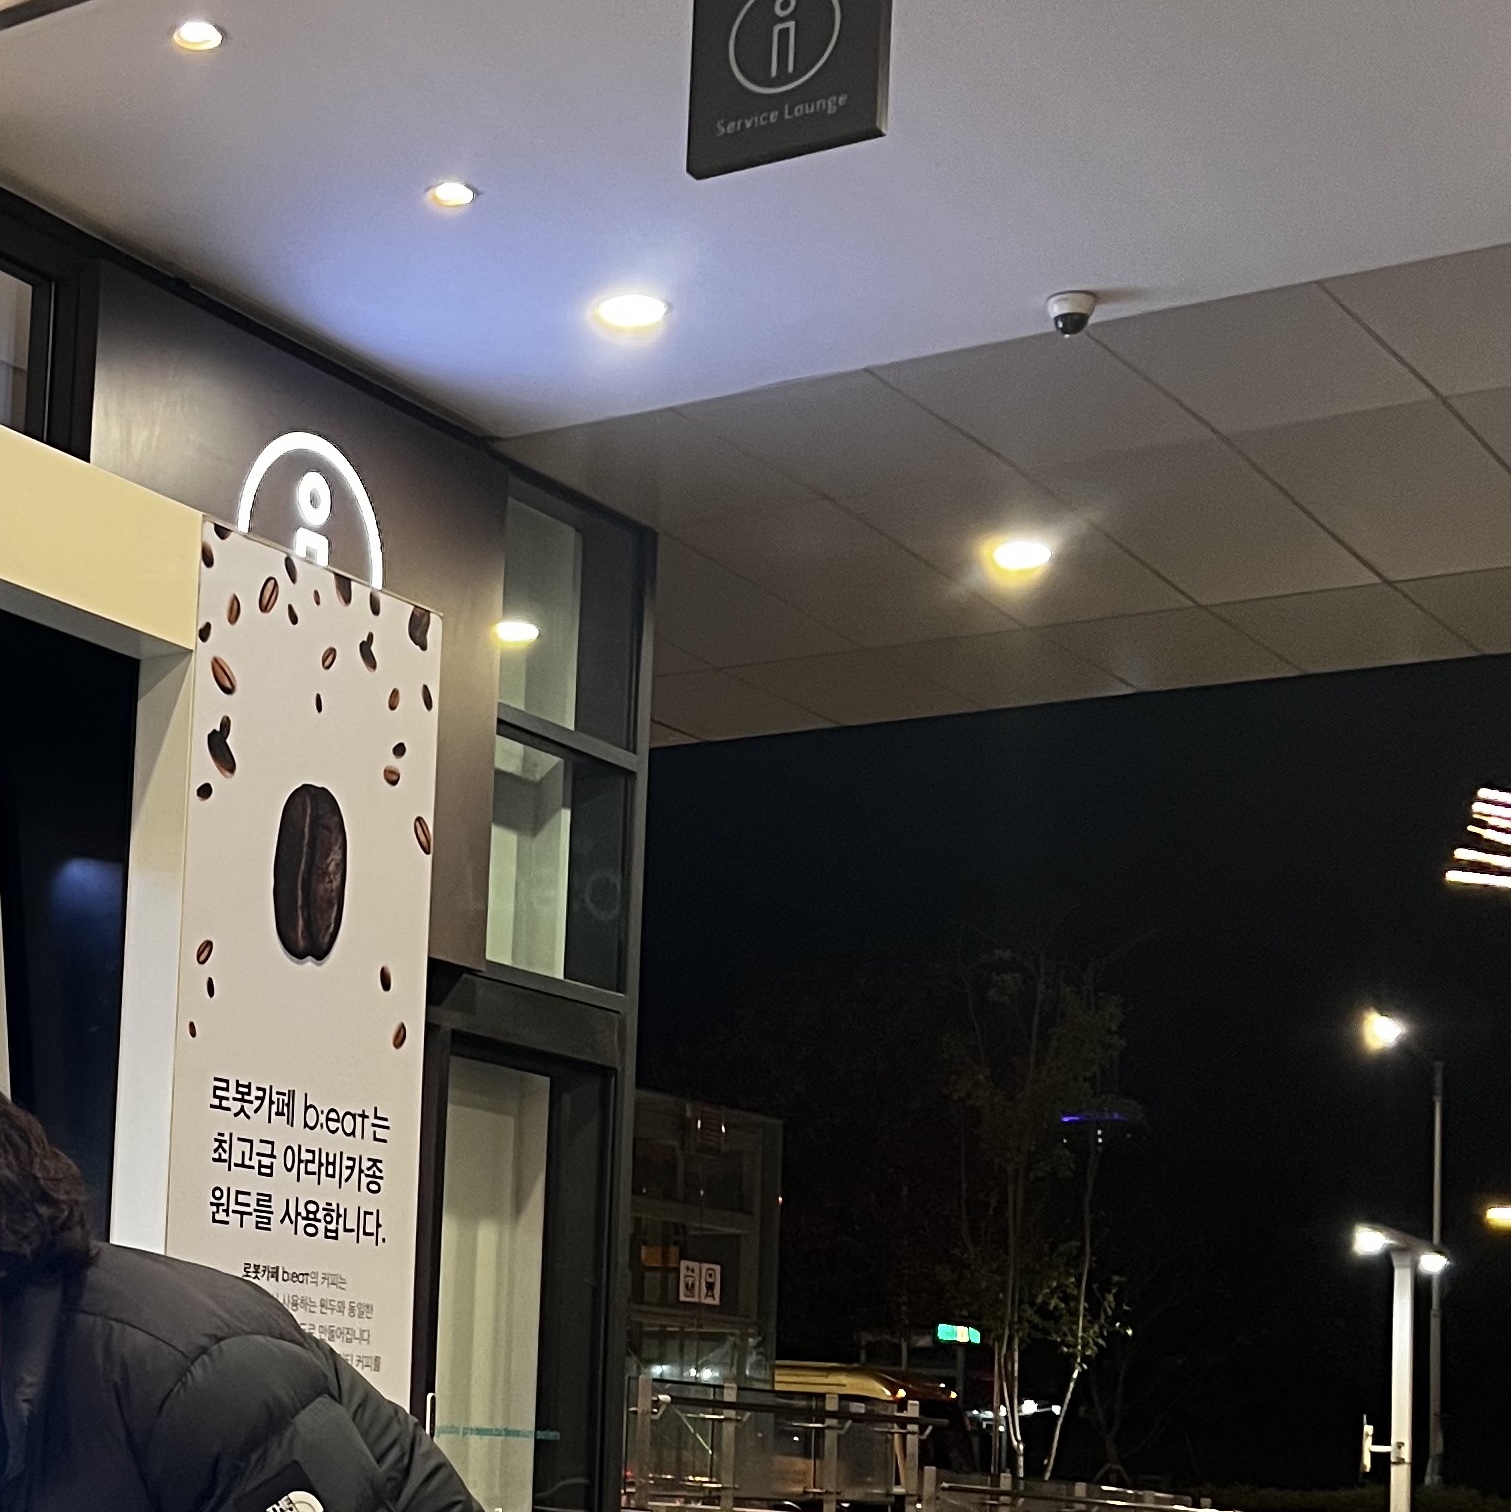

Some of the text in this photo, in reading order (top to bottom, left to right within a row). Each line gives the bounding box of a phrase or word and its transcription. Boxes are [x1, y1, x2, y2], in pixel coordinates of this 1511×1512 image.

[716, 93, 849, 136] Service Lounge
[209, 1076, 391, 1144] 로봇카페 b:eat는
[211, 1132, 385, 1195] 최고급 아라비카종
[209, 1186, 387, 1247] 원두를 사용합니다.
[241, 1262, 280, 1283] 로봇카페
